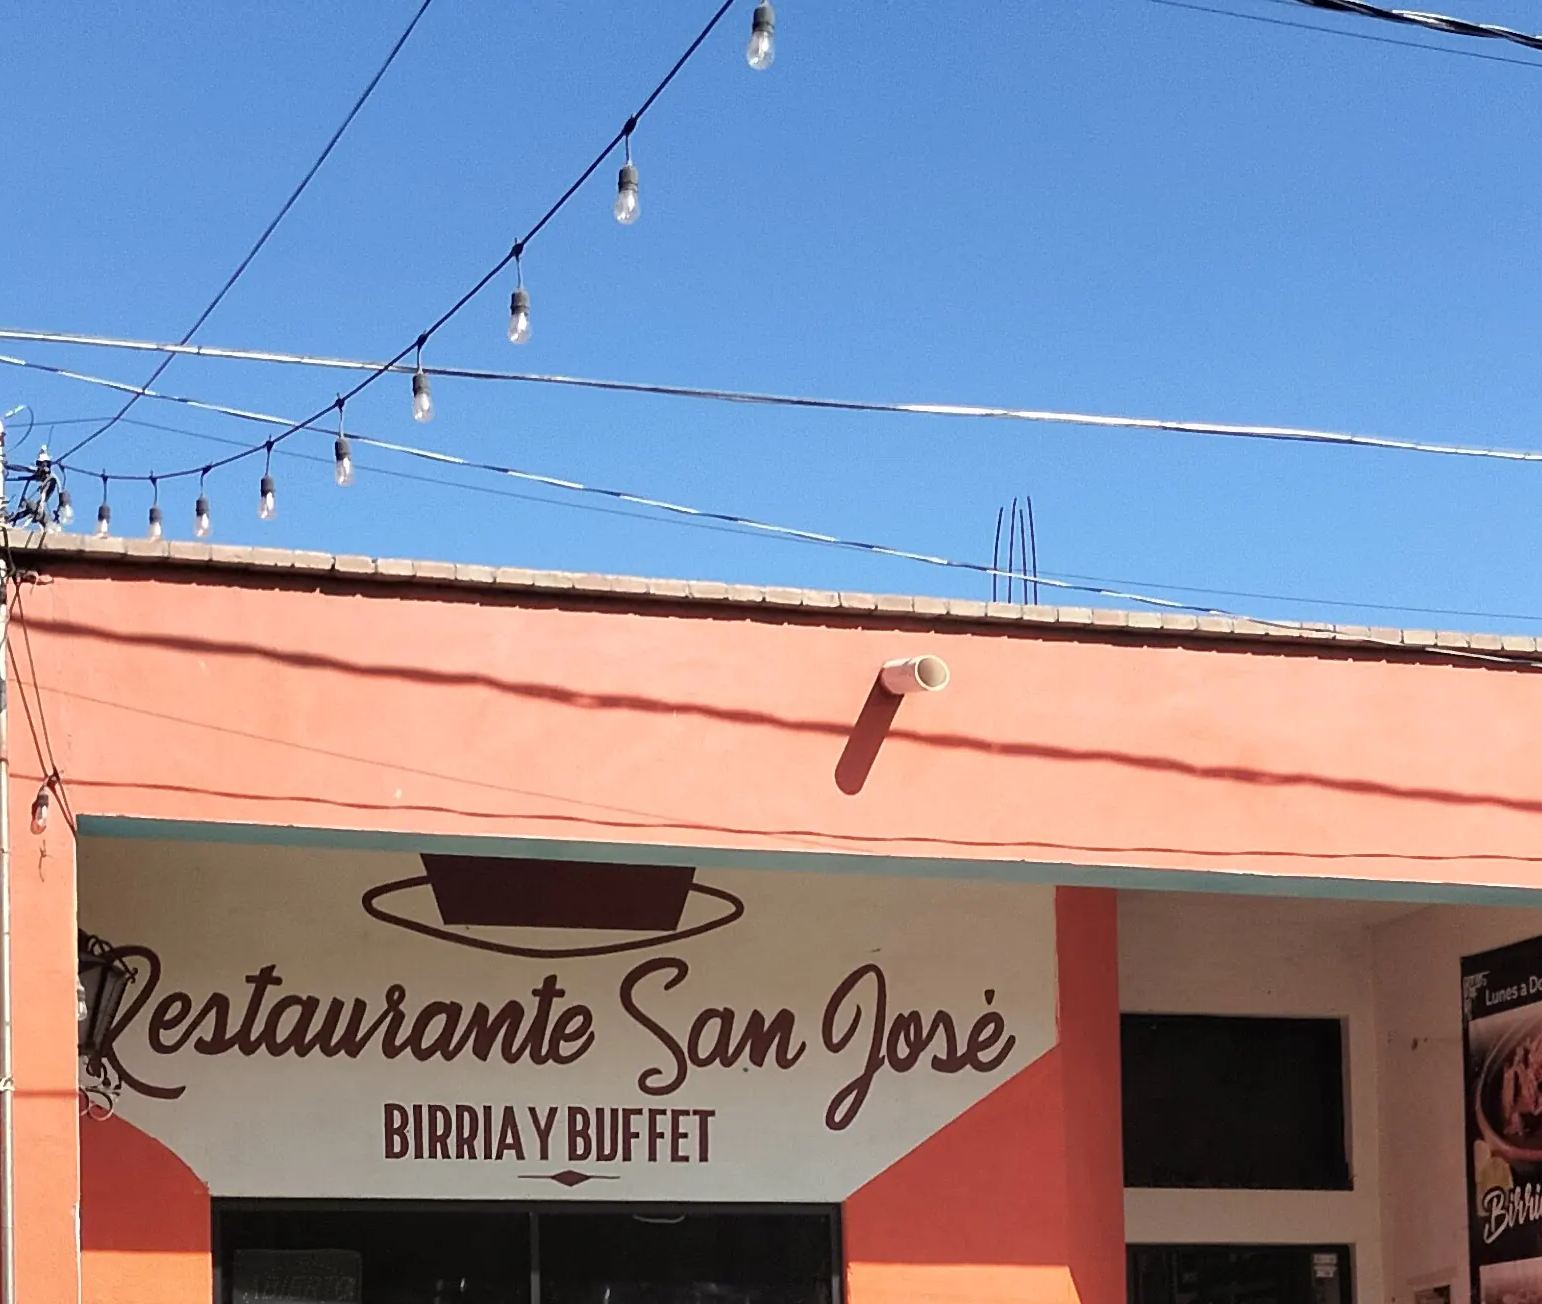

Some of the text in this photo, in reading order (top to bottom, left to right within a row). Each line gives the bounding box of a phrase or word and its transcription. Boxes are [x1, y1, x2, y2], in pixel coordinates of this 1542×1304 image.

[1484, 982, 1519, 1006] Lunes
[1520, 984, 1528, 997] a
[108, 945, 1014, 1131] Restaurante San José
[384, 1103, 716, 1162] BIRRIA Y BUFFET
